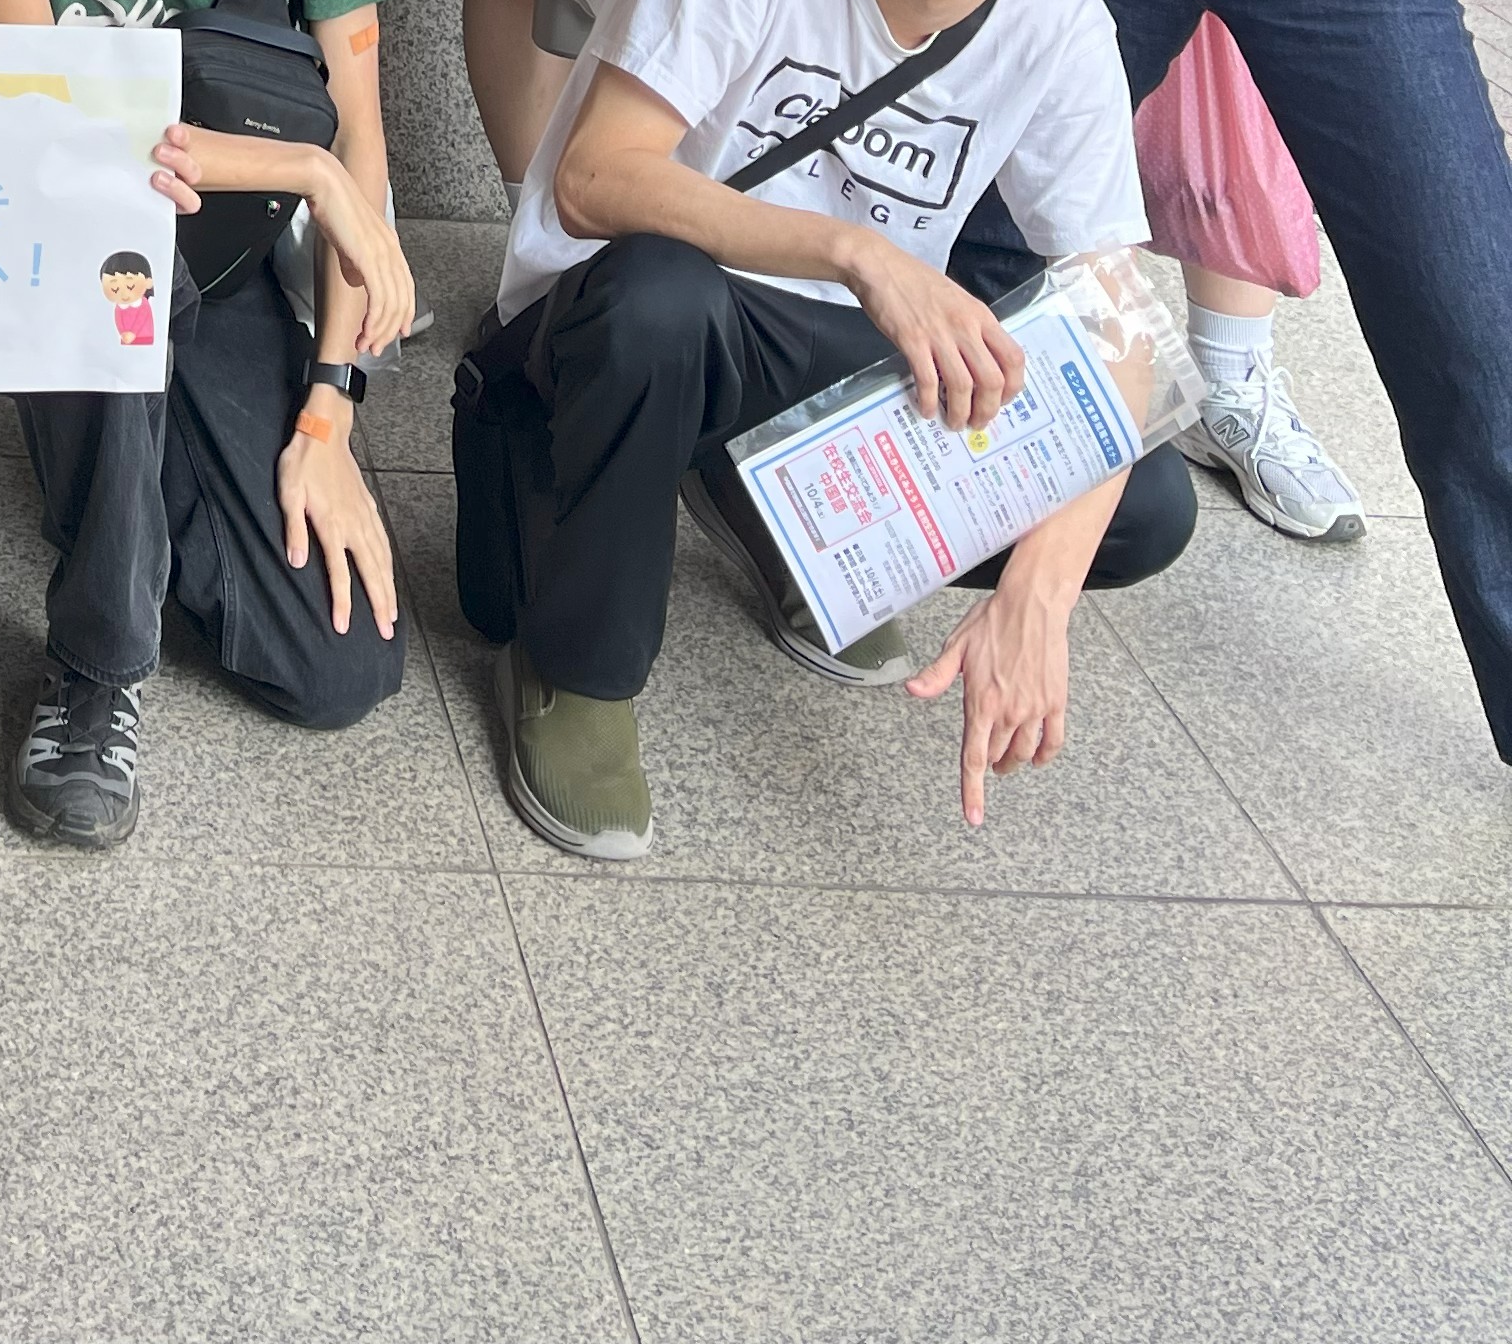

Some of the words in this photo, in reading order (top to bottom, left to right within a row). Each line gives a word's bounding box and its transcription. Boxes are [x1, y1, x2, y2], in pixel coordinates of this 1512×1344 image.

[803, 482, 823, 509] 10/4
[816, 471, 848, 514] 中国語
[822, 442, 874, 526] 在校生交流会
